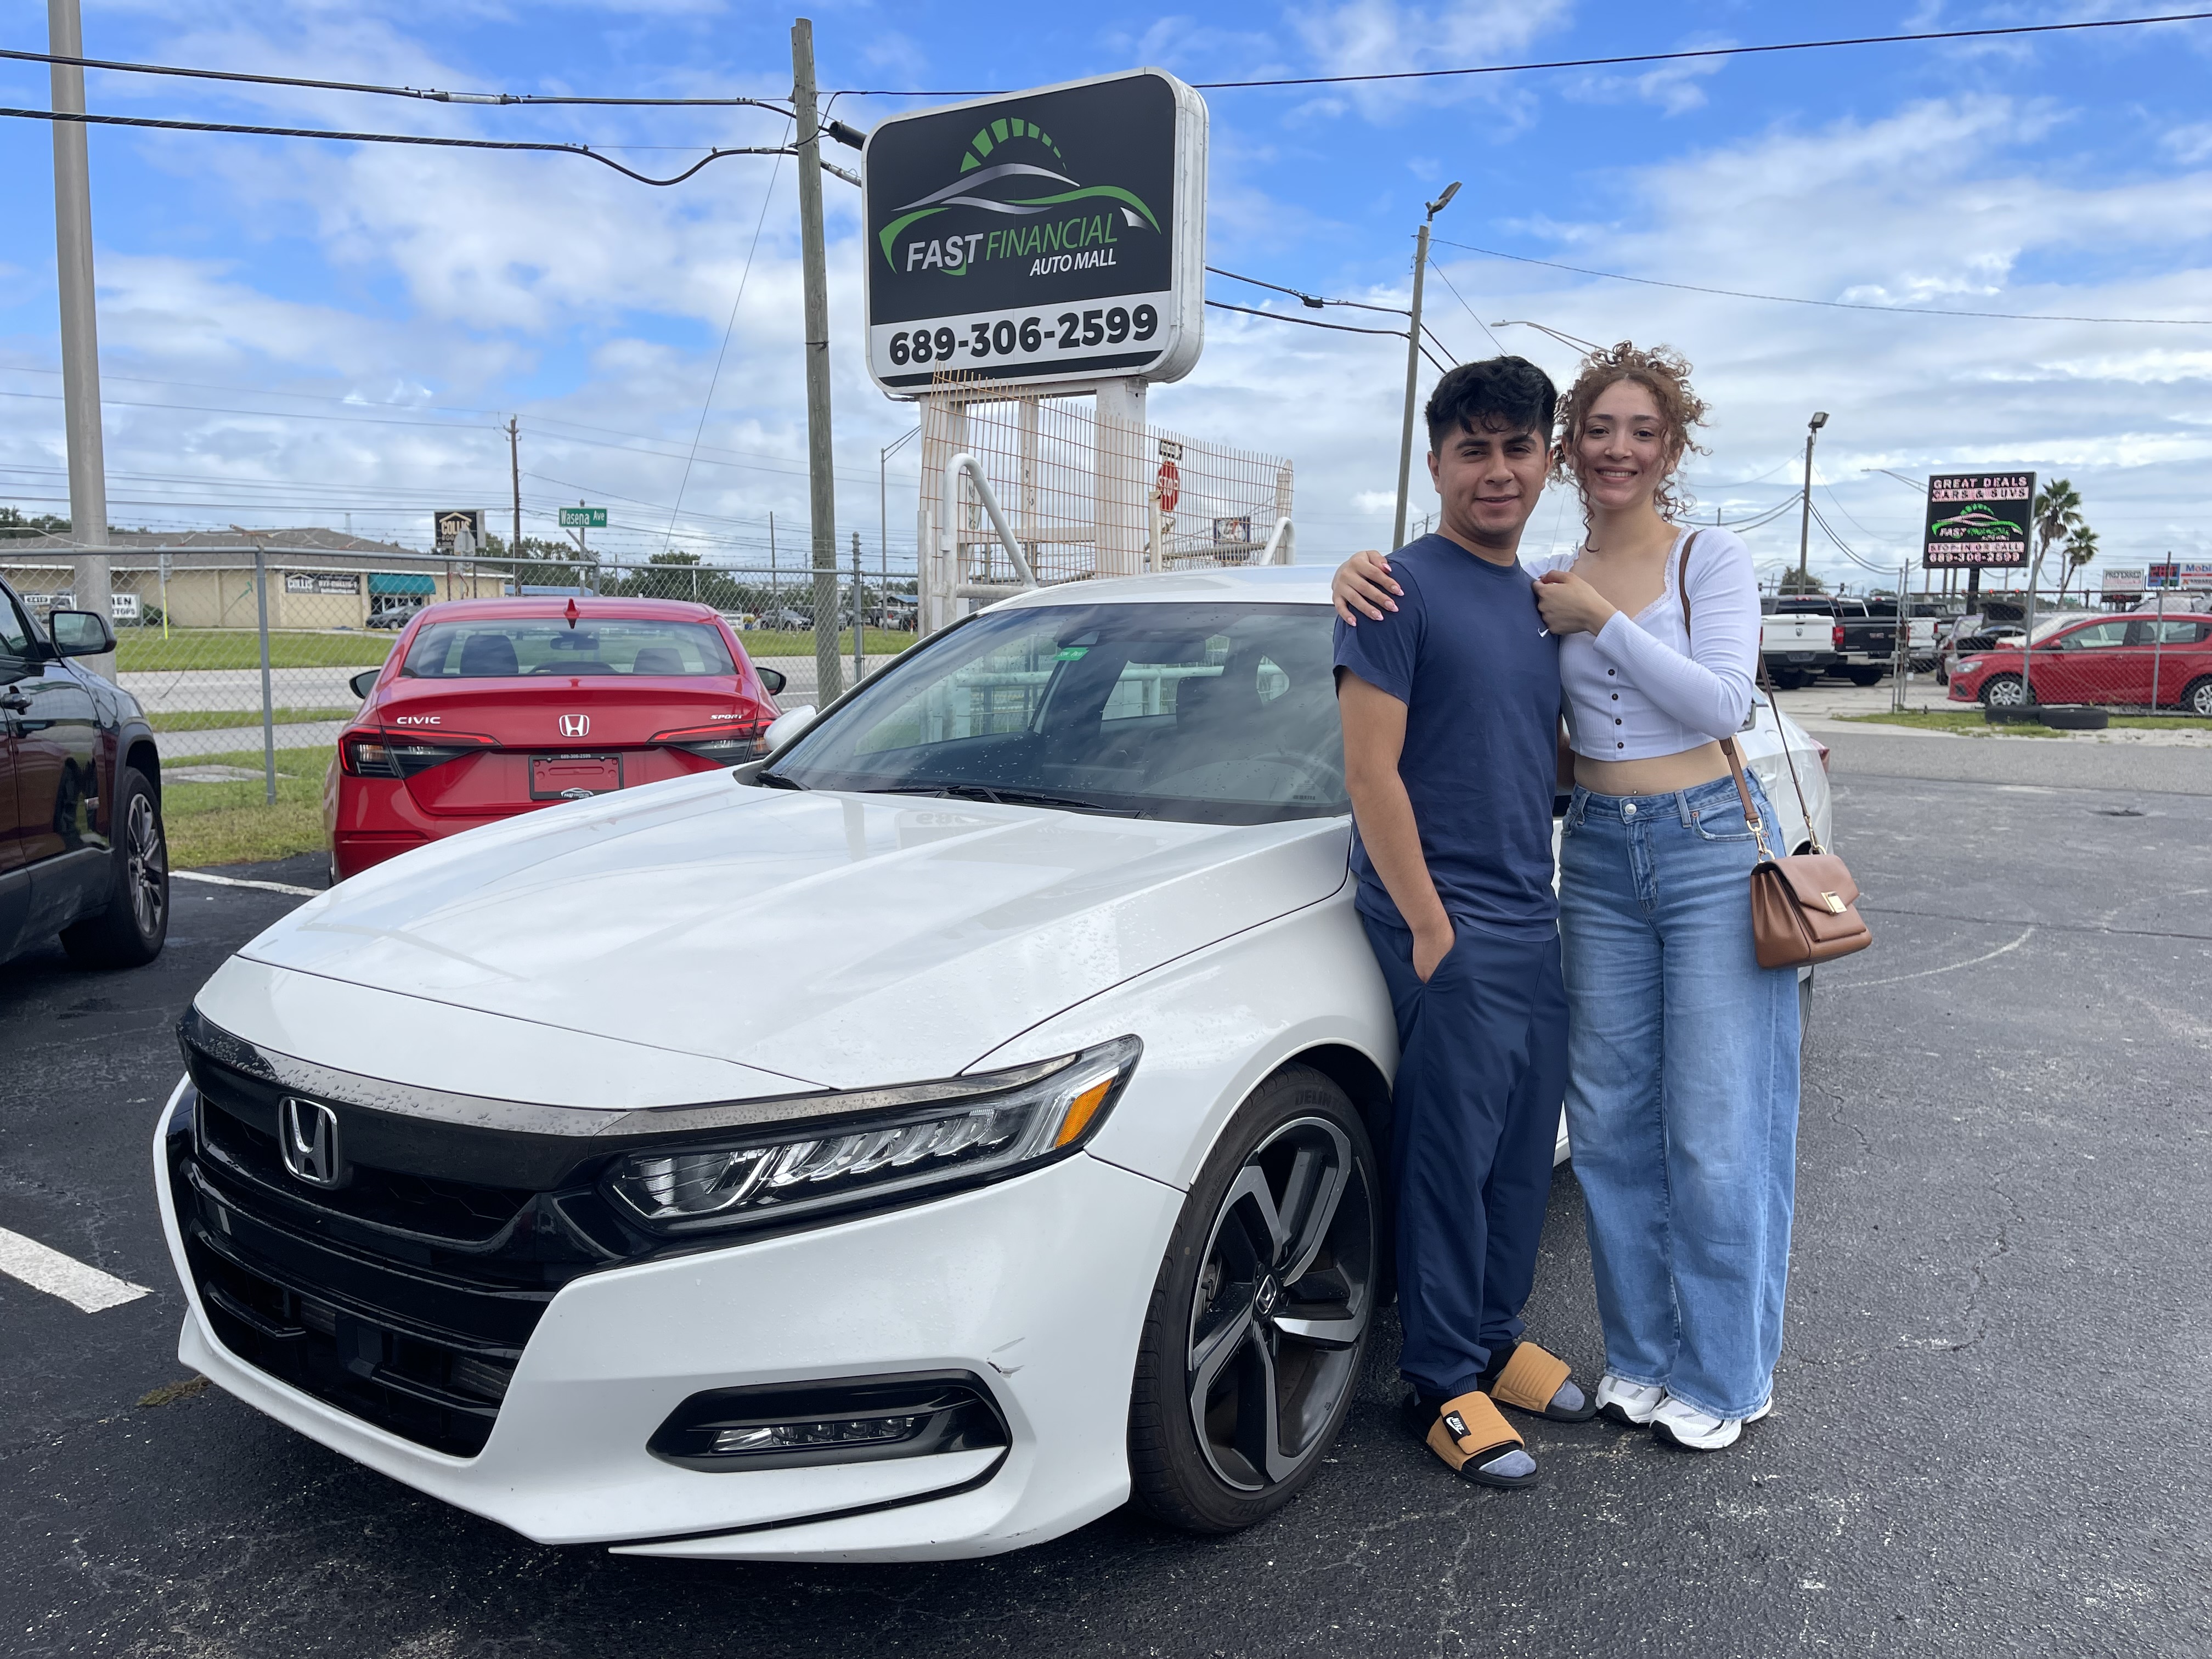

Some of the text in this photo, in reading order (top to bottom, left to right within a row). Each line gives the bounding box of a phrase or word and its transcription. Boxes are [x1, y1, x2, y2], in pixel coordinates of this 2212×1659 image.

[906, 213, 1118, 272] FAST FINANCIAL
[1030, 249, 1116, 276] AUTO MALL
[889, 303, 1158, 365] 689-306-2599
[1933, 476, 2027, 489] GREAT DEALS
[561, 510, 605, 525] Wasena Ave
[1451, 1417, 1464, 1431] NIKE
